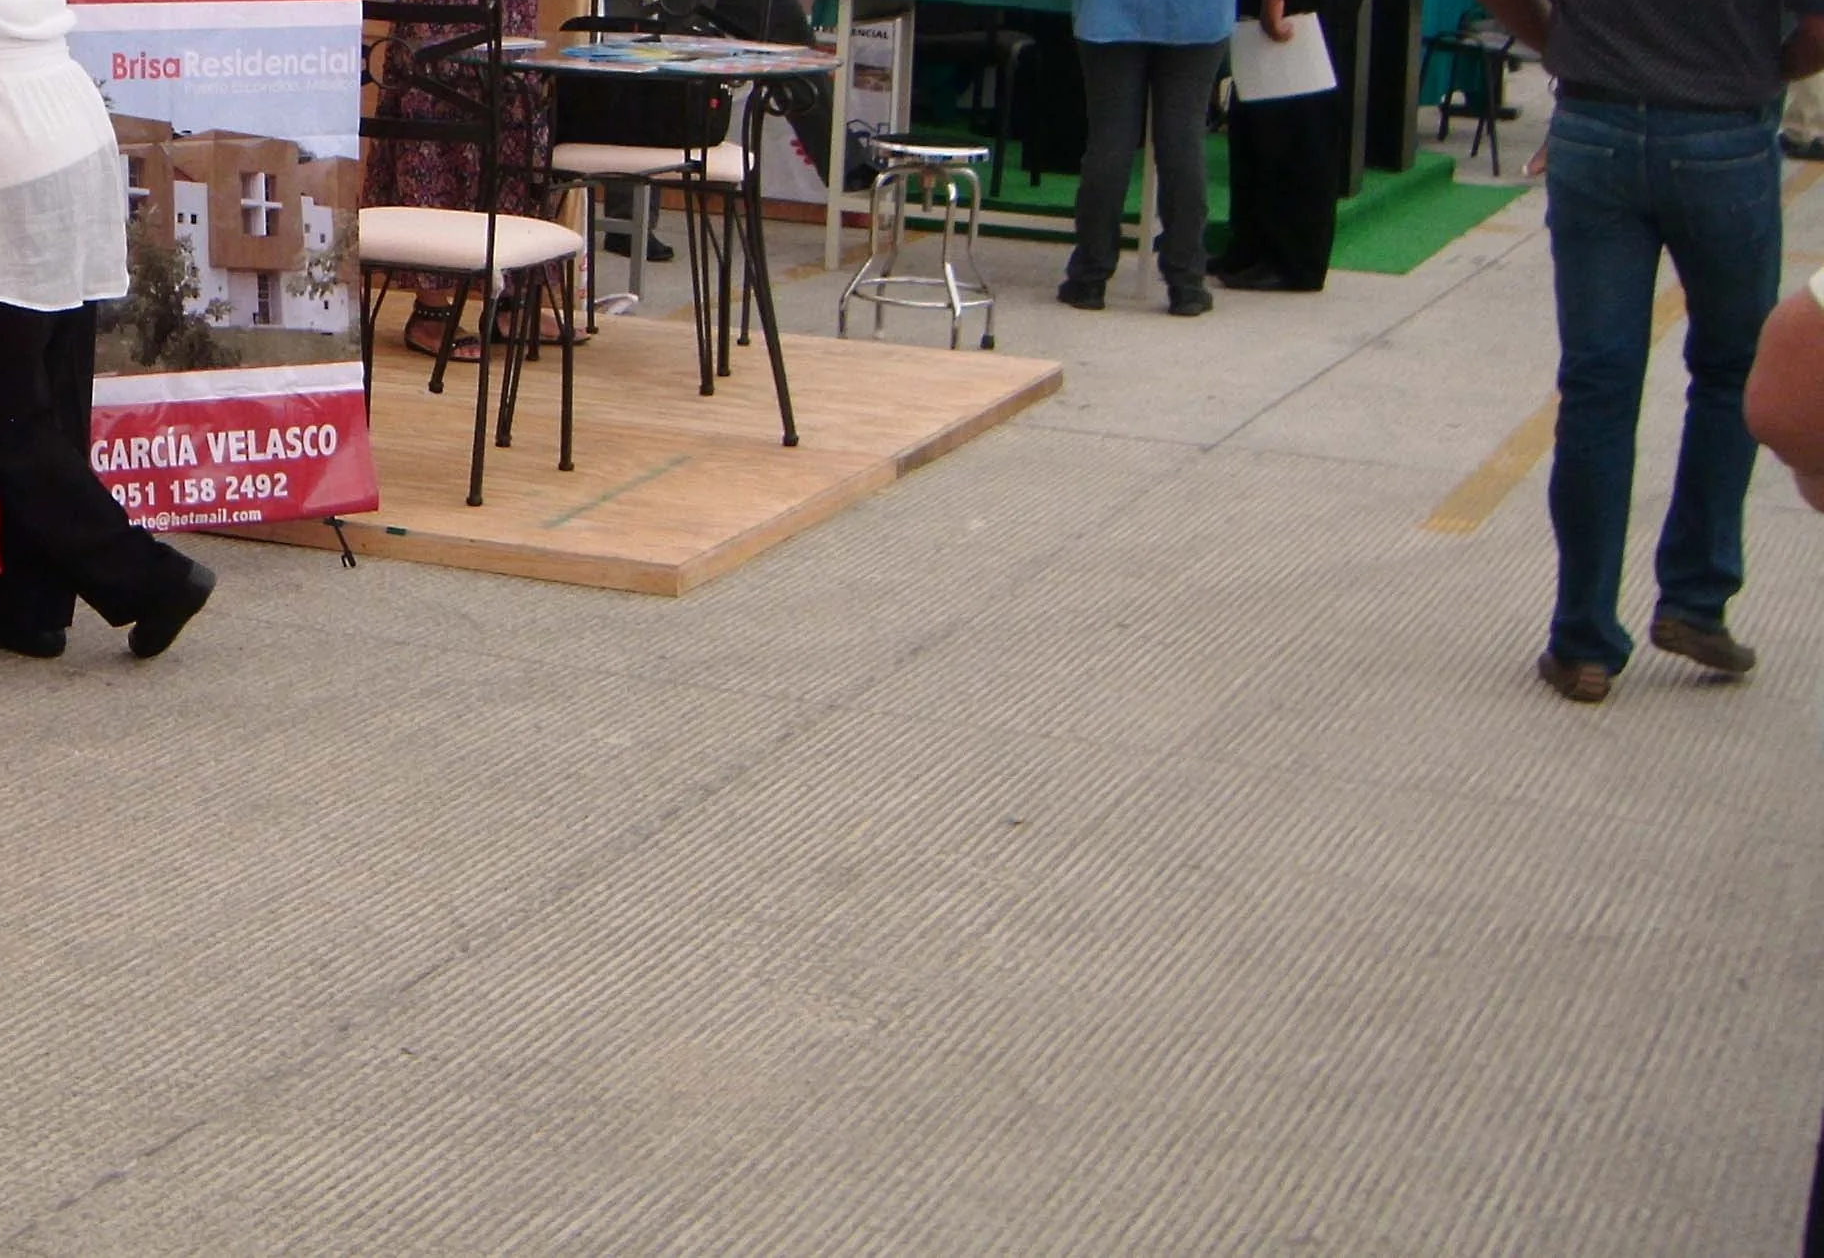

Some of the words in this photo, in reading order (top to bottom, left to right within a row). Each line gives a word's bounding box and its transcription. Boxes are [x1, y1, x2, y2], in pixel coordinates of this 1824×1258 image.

[90, 426, 198, 472] GARCÍA
[207, 424, 338, 463] VELASCO
[111, 482, 156, 508] 951
[170, 477, 216, 504] 158
[225, 472, 288, 500] 2492
